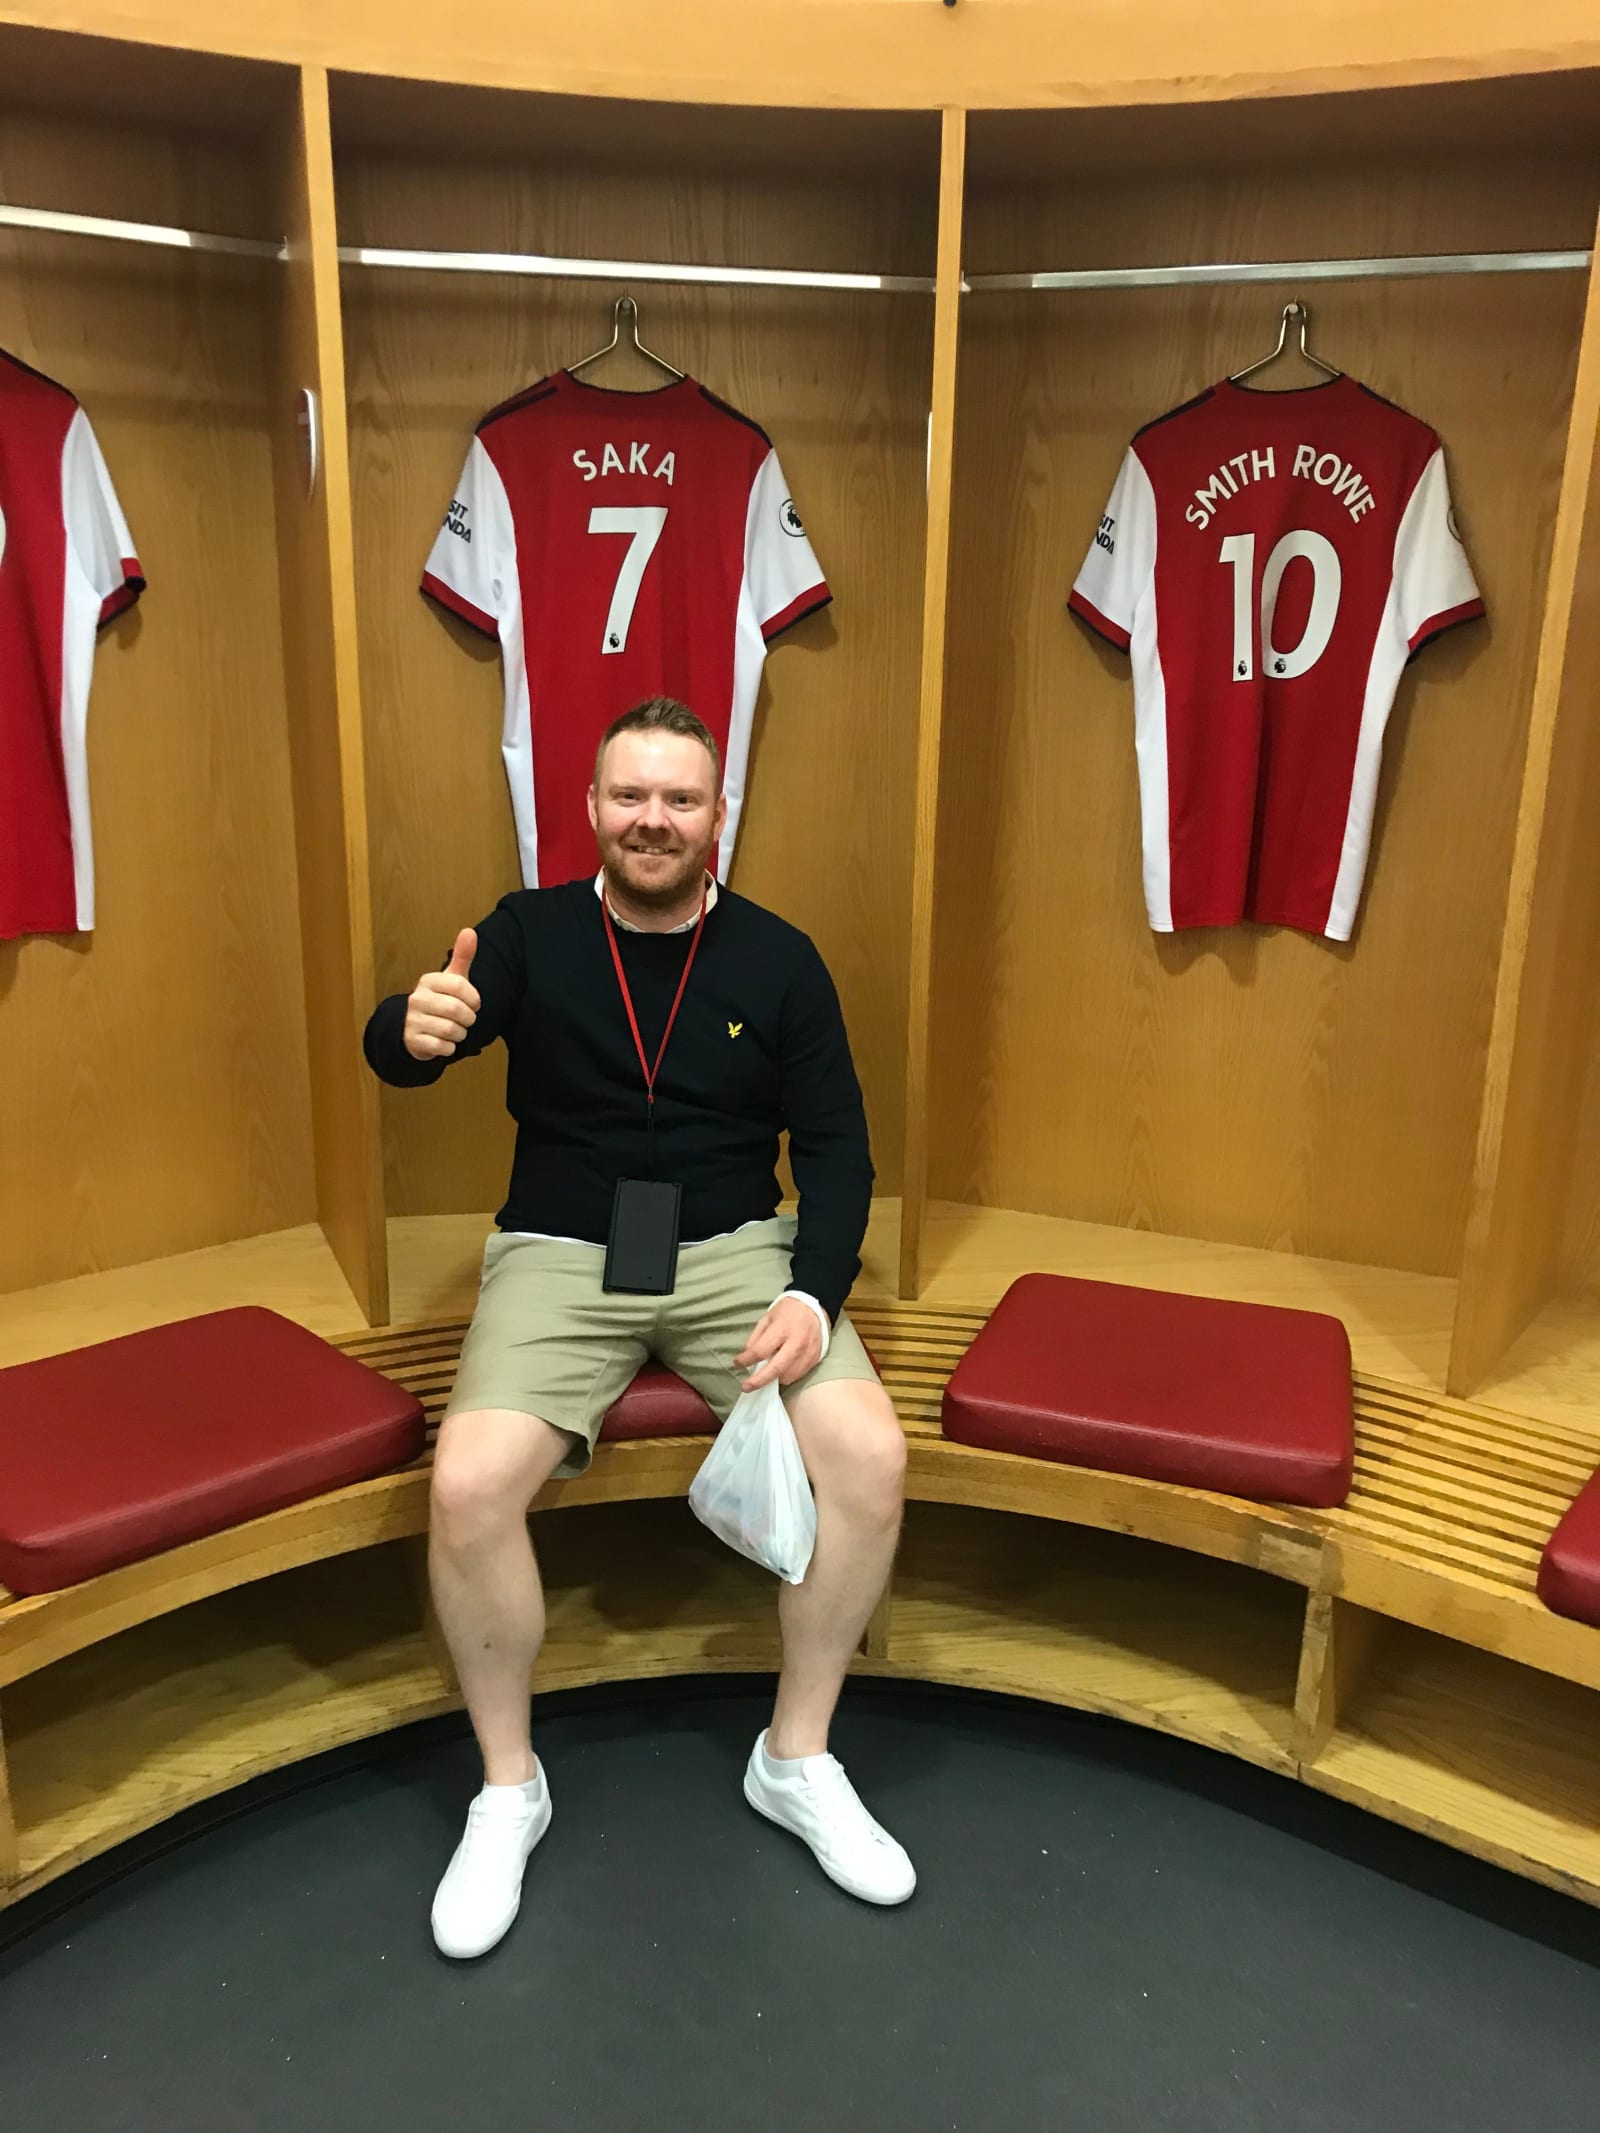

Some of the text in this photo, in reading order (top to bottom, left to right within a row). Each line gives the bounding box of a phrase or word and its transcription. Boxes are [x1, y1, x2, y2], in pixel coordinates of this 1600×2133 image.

[573, 442, 676, 486] SAKA
[1185, 444, 1376, 531] SMITH ROWE
[588, 507, 668, 655] 7
[1218, 529, 1342, 682] 10
